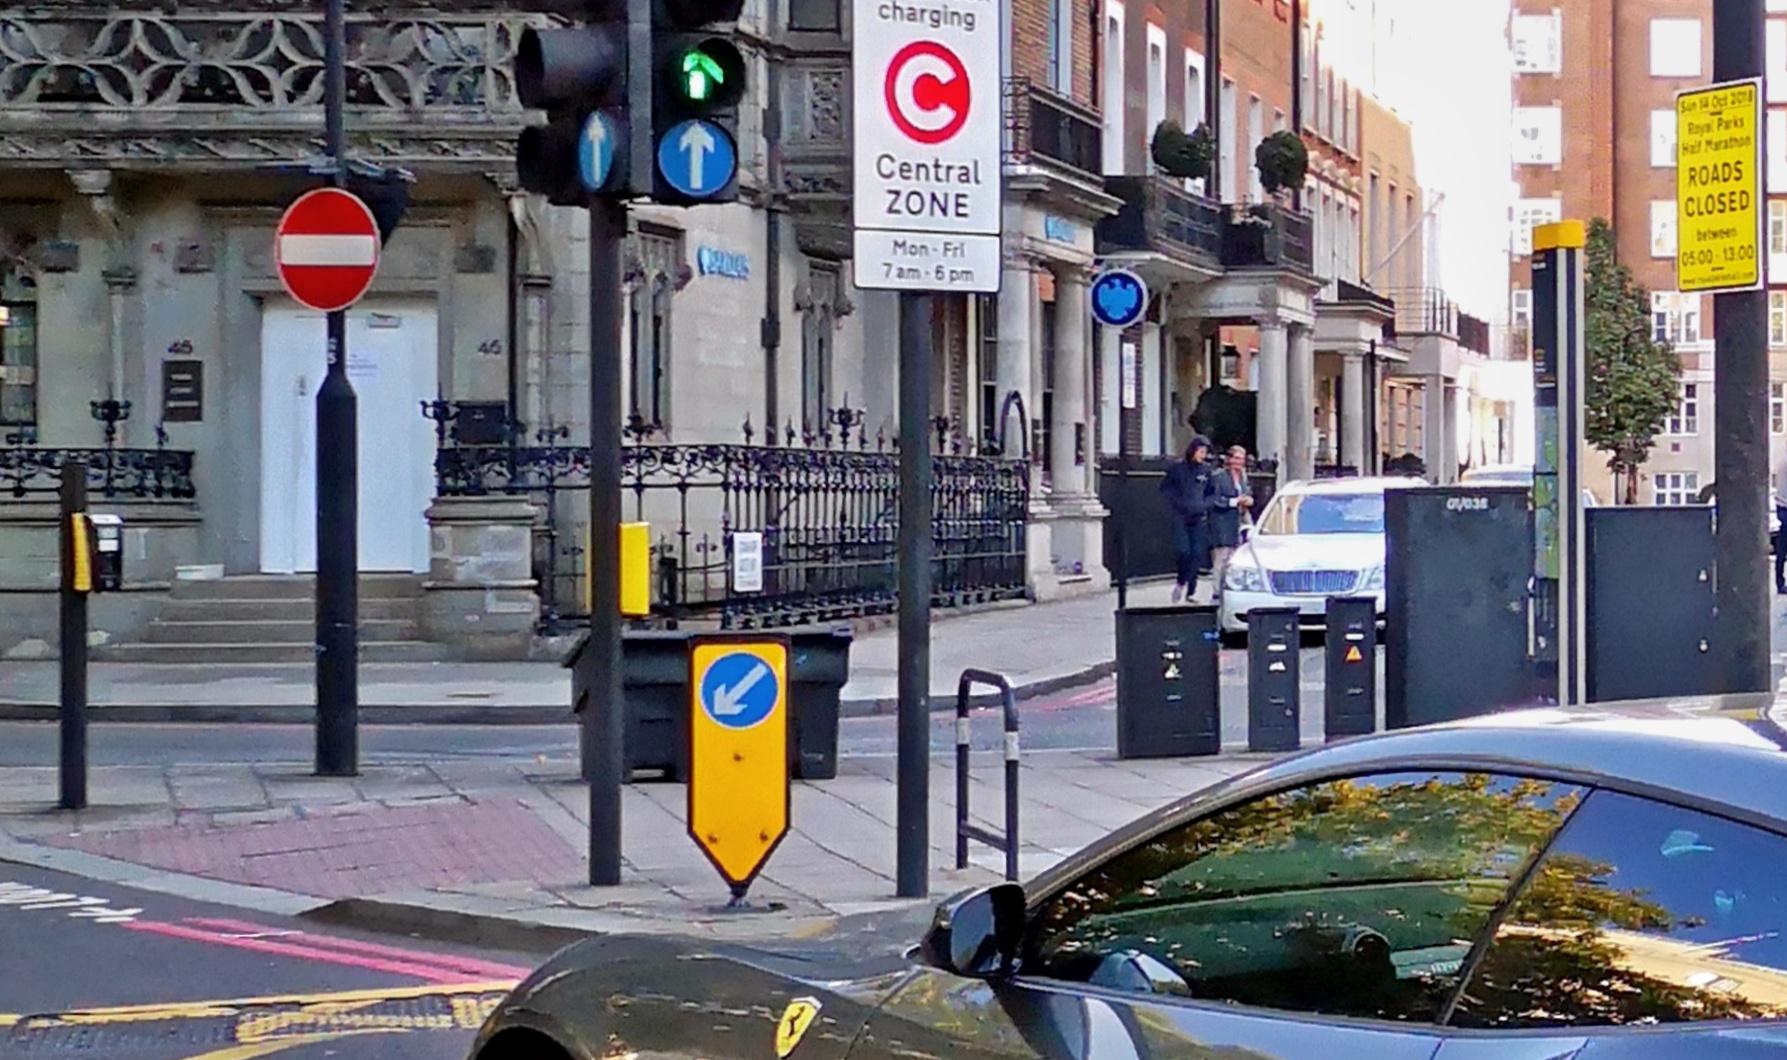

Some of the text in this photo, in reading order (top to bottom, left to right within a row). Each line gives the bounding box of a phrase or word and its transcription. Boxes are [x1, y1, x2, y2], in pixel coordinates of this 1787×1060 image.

[879, 1, 976, 32] charging
[1711, 94, 1728, 108] Oct
[1687, 116, 1745, 137] Royal Parks
[1682, 136, 1751, 156] Half Marathon
[876, 153, 981, 185] Central
[1688, 160, 1744, 187] ROADS
[886, 189, 970, 218] ZONE
[1684, 189, 1750, 217] CLOSED
[1697, 227, 1738, 242] between
[892, 240, 929, 257] Mon
[943, 242, 966, 258] Fri
